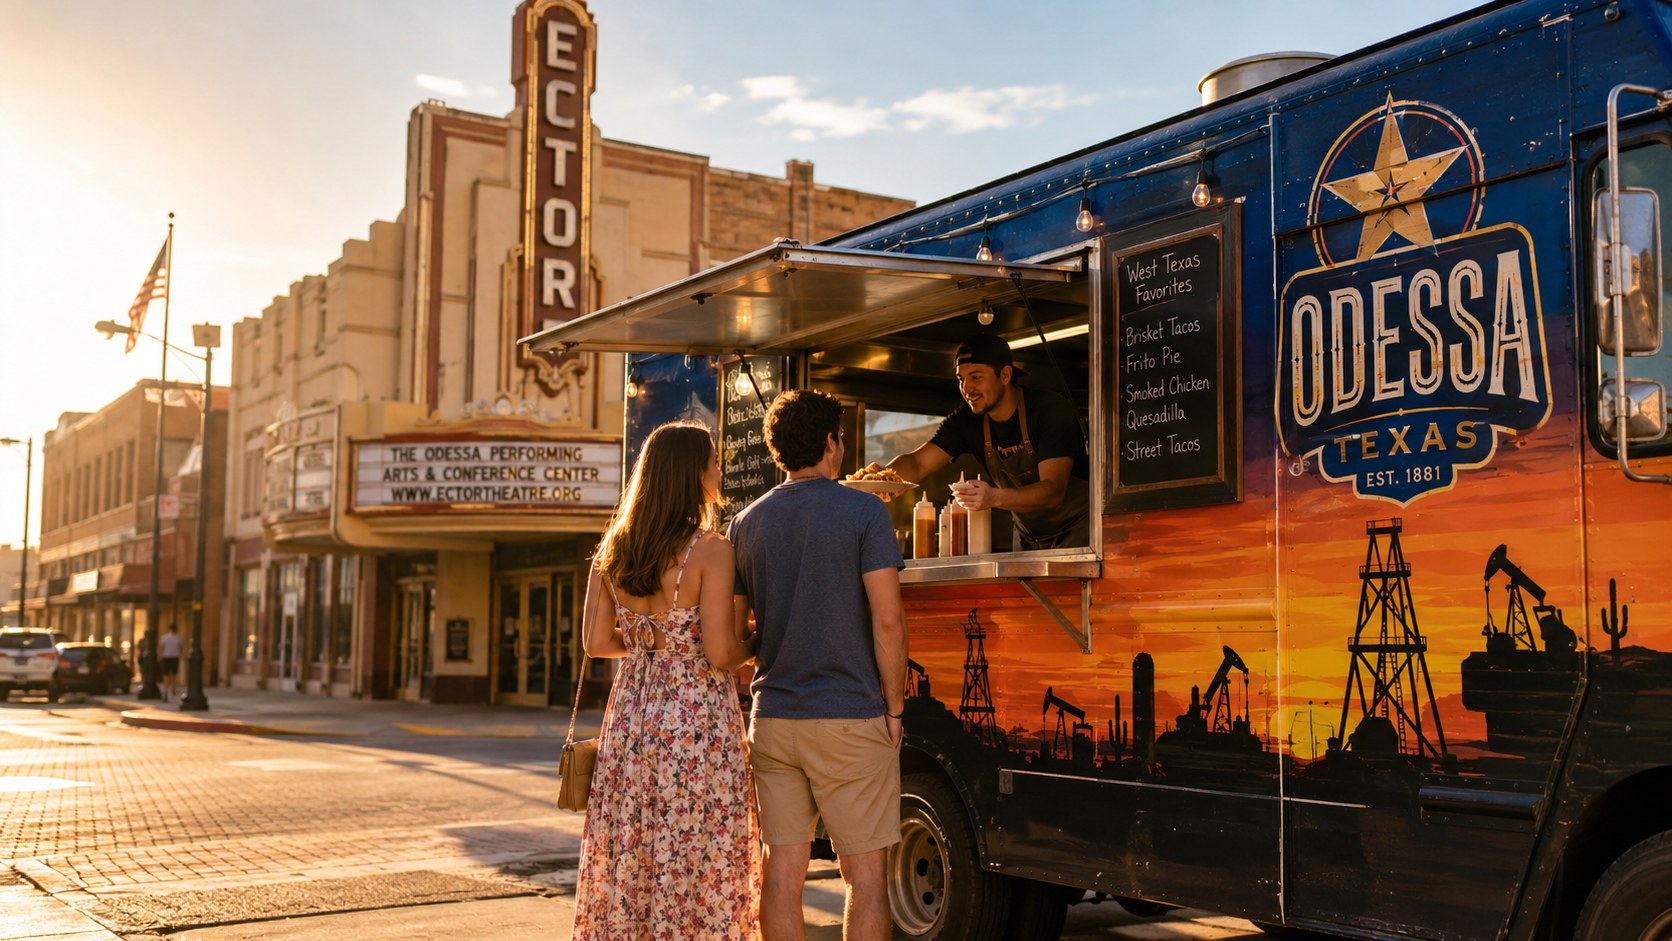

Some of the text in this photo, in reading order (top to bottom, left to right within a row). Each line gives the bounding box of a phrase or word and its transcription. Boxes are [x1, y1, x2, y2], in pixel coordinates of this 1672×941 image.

[542, 20, 578, 332] ECTOR
[1126, 253, 1201, 283] West Texas
[1135, 277, 1193, 304] Favorites
[1126, 317, 1201, 347] Brisket Tacos
[1291, 249, 1540, 427] ODESSA
[1126, 346, 1182, 374] Frito Pie
[1126, 373, 1210, 404] Smoked Chicken
[1126, 403, 1187, 430] Quesadilla
[391, 446, 582, 462] THE ODESSA PERFORMING
[1126, 433, 1201, 462] Street Tacos
[1334, 420, 1478, 463] TEXAS
[383, 466, 599, 483] ARTS & CONFERENCE CENTER
[1366, 466, 1441, 488] EST. 1881
[391, 486, 582, 502] WWW.ECTORTHEATRE.ORG
